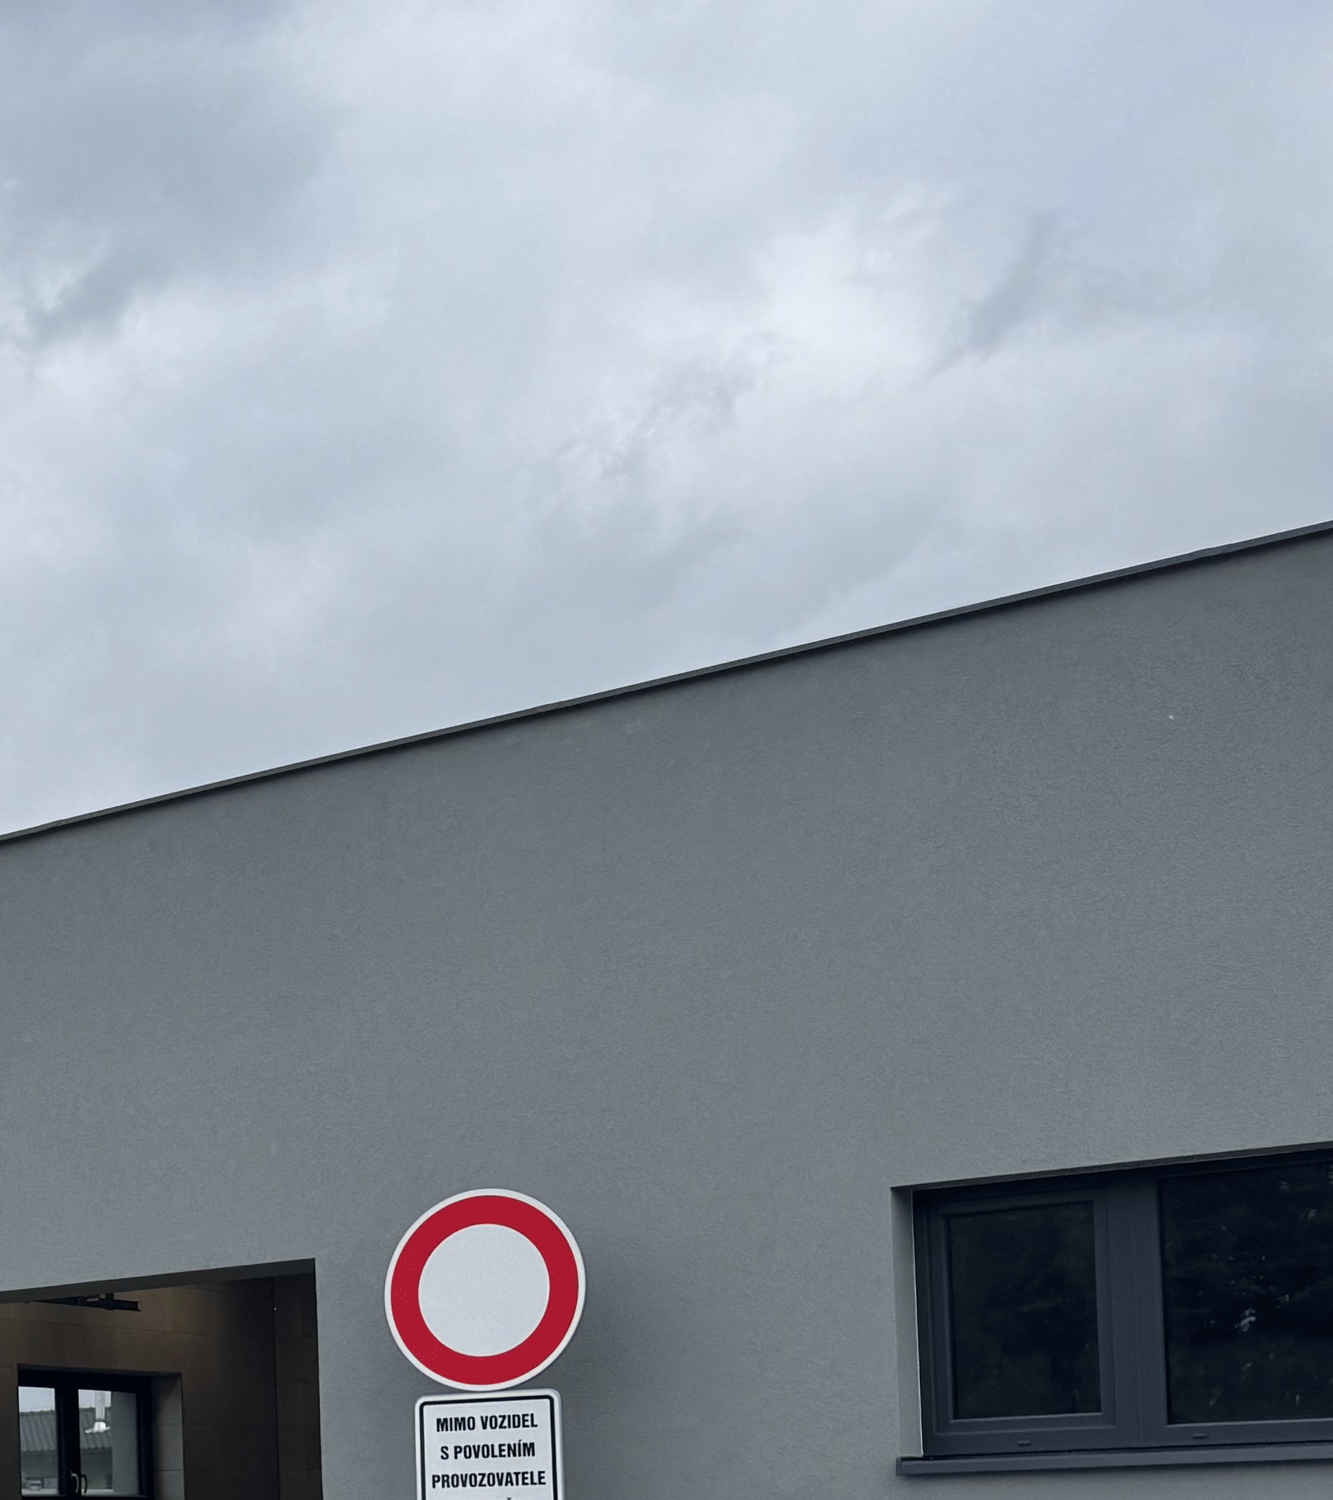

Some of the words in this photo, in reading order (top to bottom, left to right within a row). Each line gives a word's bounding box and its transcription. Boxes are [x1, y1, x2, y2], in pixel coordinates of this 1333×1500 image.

[436, 1416, 476, 1432] MIMO
[480, 1413, 538, 1430] VOZIDEL
[440, 1446, 449, 1460] S
[453, 1439, 536, 1459] POVOLENÍM
[431, 1470, 546, 1489] PROVOZOVATELE
